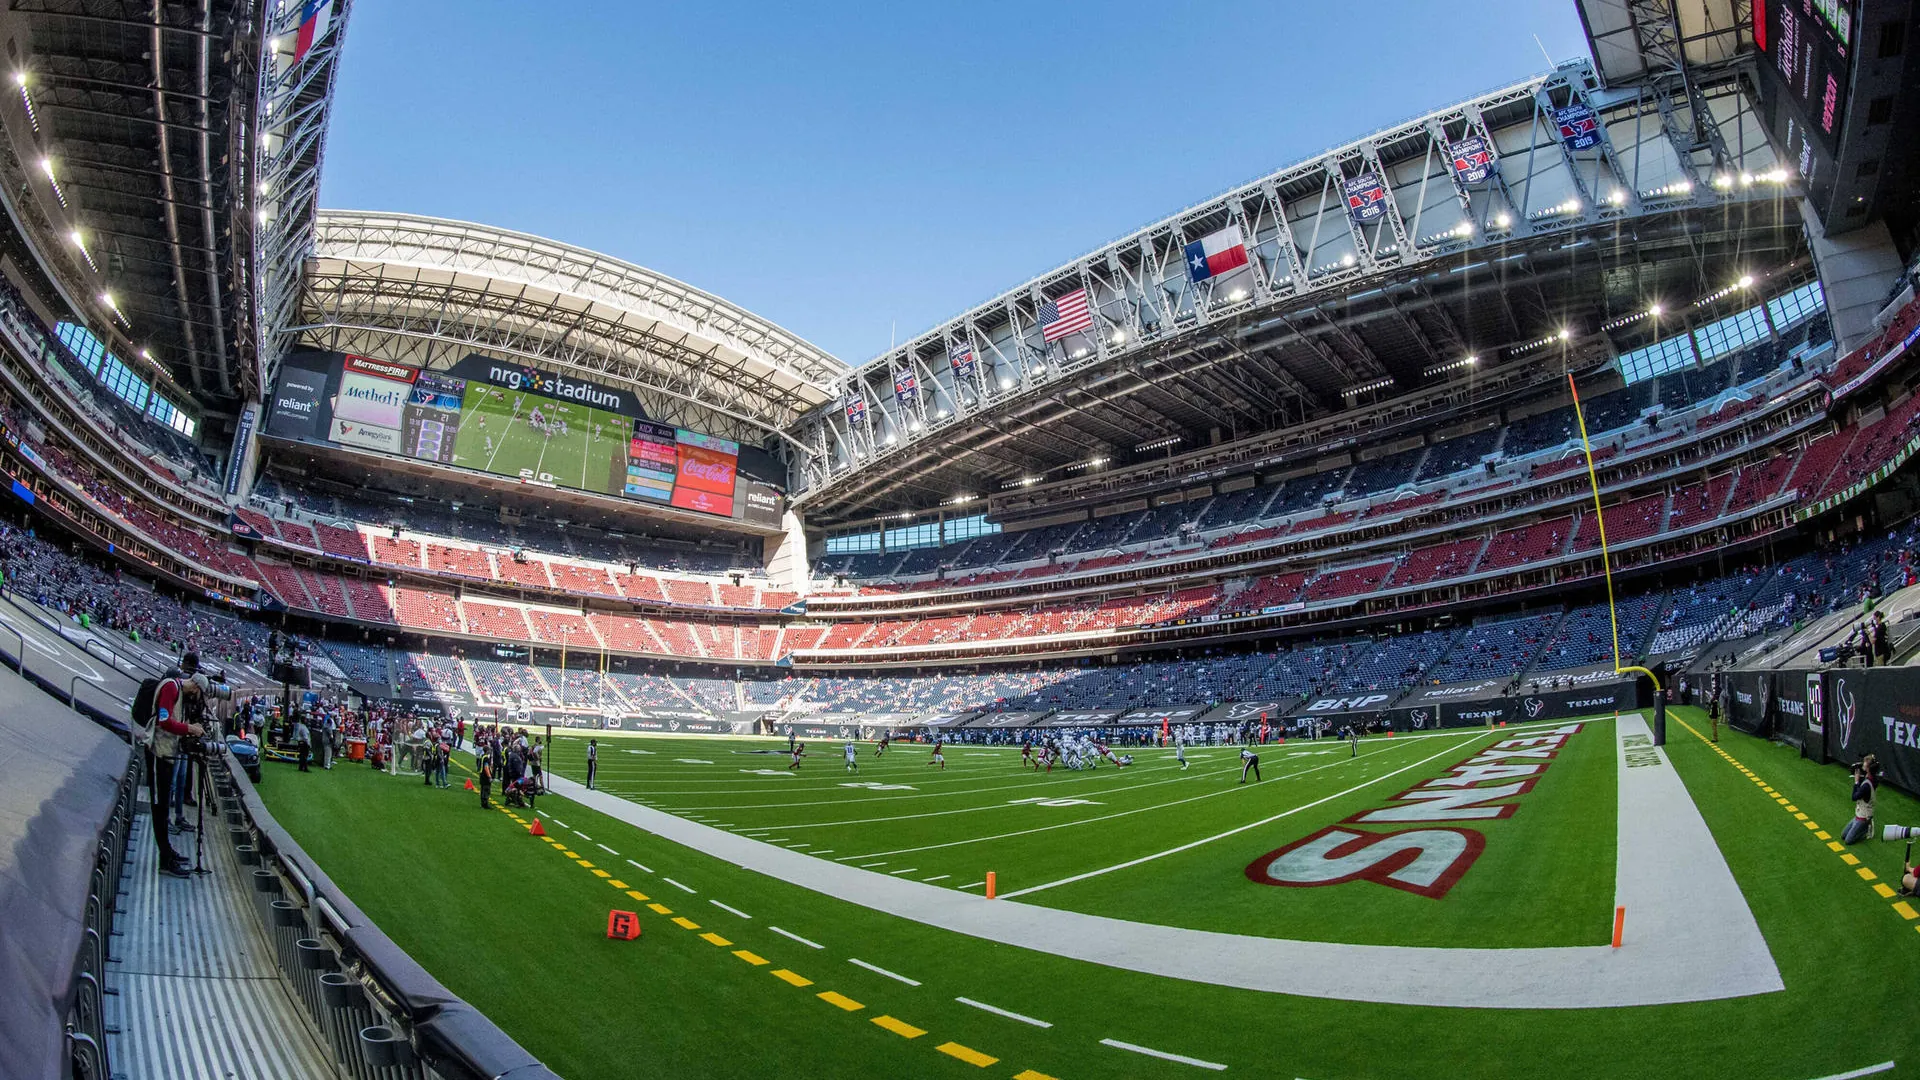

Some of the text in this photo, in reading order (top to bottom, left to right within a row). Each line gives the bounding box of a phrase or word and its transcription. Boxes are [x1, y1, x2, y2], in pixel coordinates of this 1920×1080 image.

[1821, 72, 1838, 135] verizon
[1556, 109, 1588, 123] CHAMPIONS
[1574, 135, 1594, 149] 2019
[1451, 142, 1481, 157] CHAMPIONS
[1466, 169, 1486, 182] 2018
[1346, 179, 1377, 194] CHAMPIONS
[1361, 205, 1380, 218] 2016
[489, 366, 521, 390] nrg
[543, 379, 620, 408] stadium
[278, 398, 312, 413] reliant
[241, 421, 252, 429] TEXT
[748, 492, 776, 506] reliant
[1424, 685, 1483, 697] reliant
[1566, 696, 1615, 709] TEXANS
[1777, 696, 1805, 717] TEXANS
[1456, 708, 1503, 720] TEXANS
[1245, 722, 1586, 900] TEXANS
[613, 913, 630, 938] G
